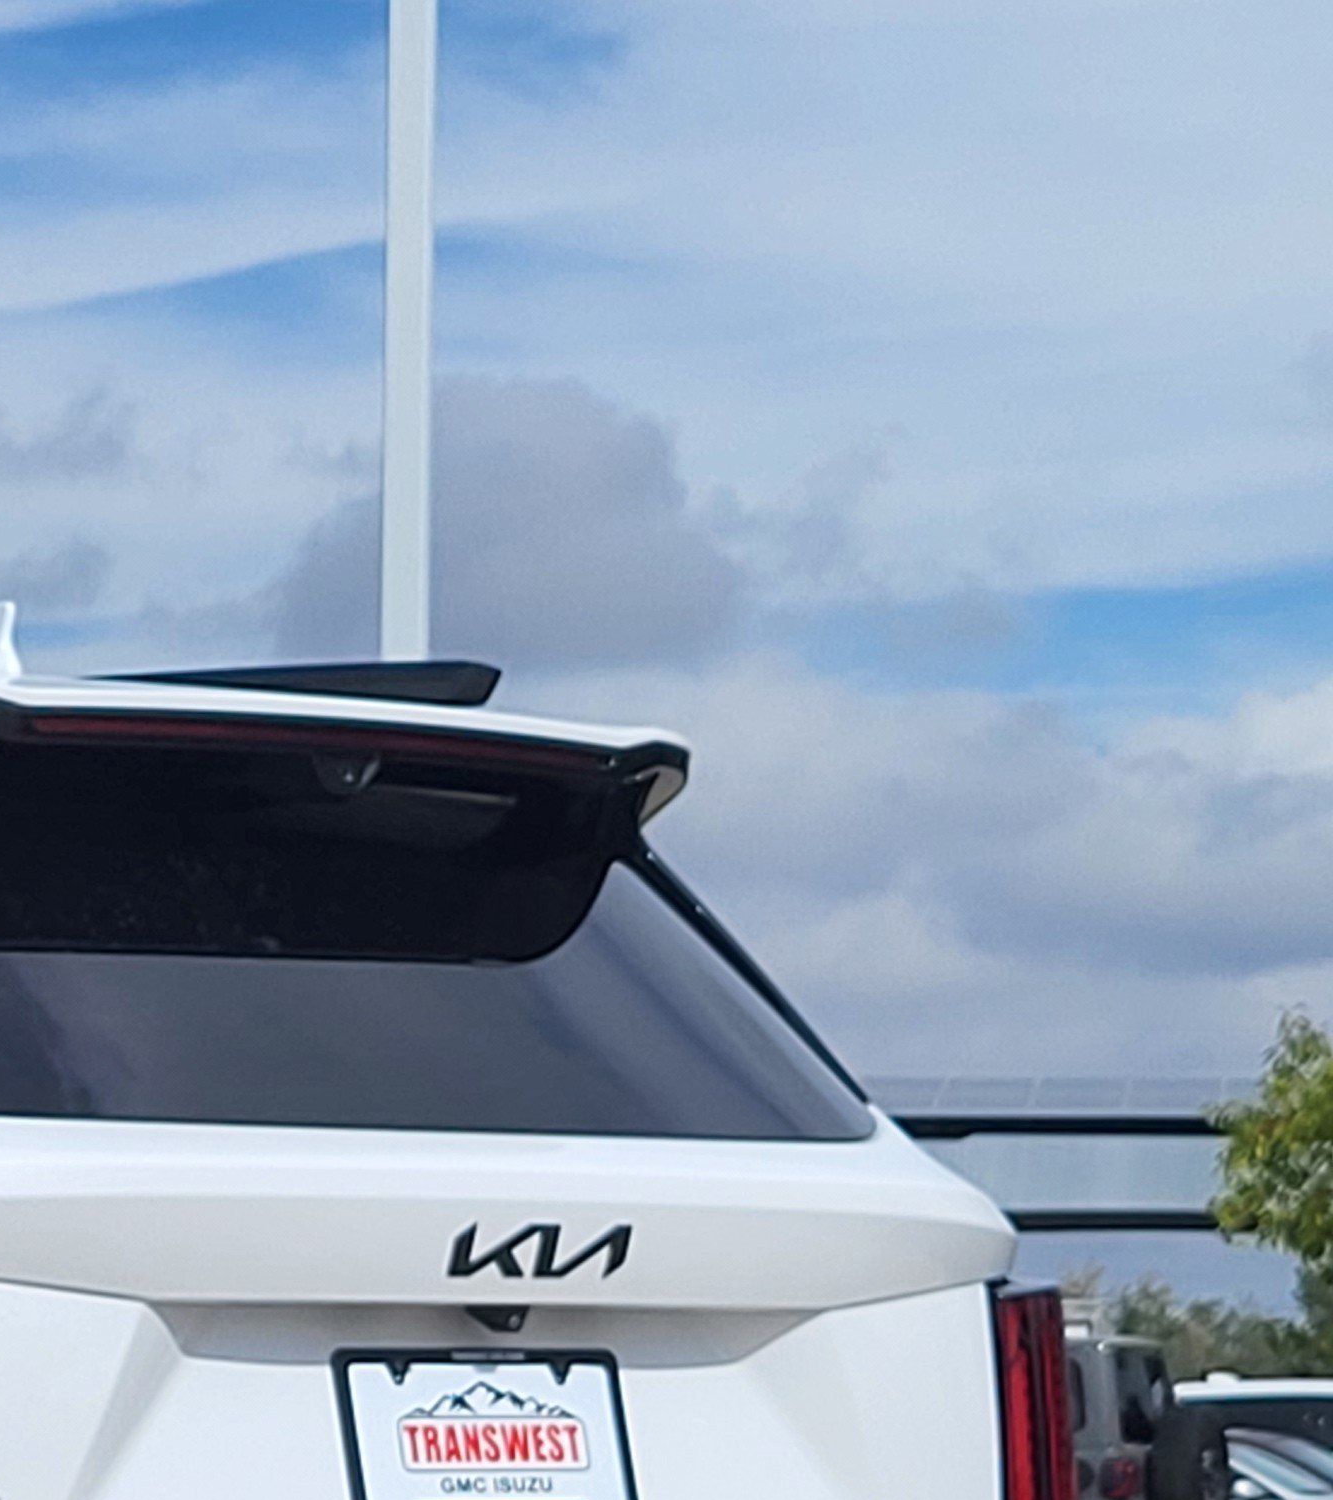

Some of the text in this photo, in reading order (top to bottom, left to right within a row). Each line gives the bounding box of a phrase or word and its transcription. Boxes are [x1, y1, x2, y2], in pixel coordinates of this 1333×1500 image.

[447, 1221, 632, 1278] KIA
[403, 1424, 579, 1463] TRANSWEST
[440, 1478, 553, 1493] GMC ISUZU
